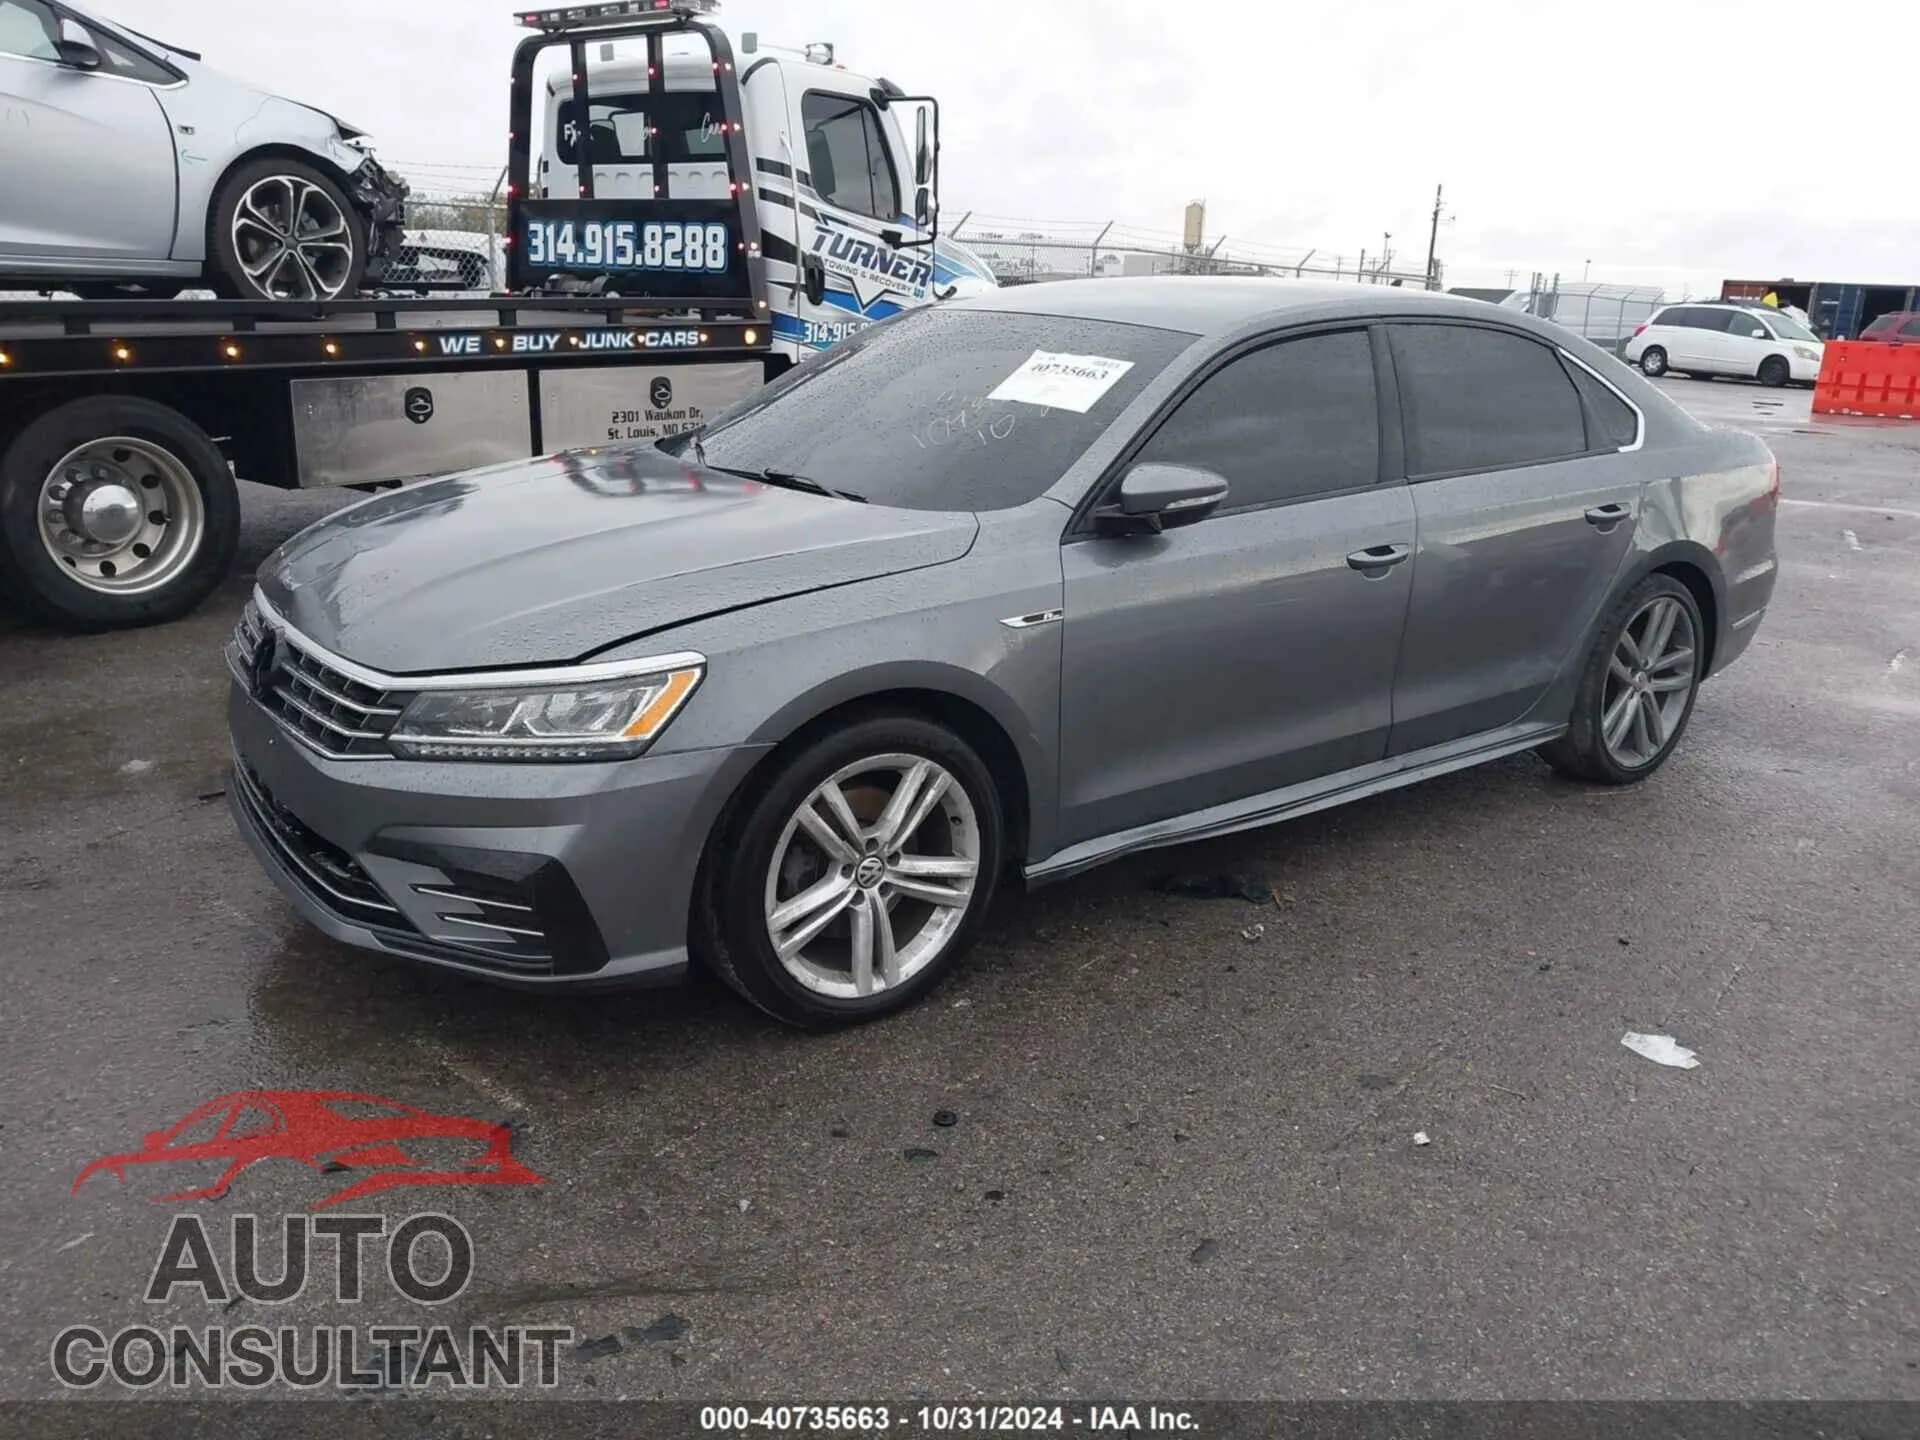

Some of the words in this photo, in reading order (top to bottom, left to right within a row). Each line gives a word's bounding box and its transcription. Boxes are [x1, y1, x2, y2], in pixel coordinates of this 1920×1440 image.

[528, 222, 726, 271] 314.915.8288
[812, 225, 932, 287] TURNER
[824, 258, 859, 276] TOWING
[869, 273, 913, 294] RECOVERY
[440, 335, 481, 354] WE
[512, 333, 561, 352] BUY
[578, 331, 636, 349] JUNK
[645, 330, 699, 347] CARS
[611, 410, 640, 424] 2301
[644, 408, 686, 421] Waukon
[607, 427, 624, 440] St.
[662, 423, 679, 436] MO
